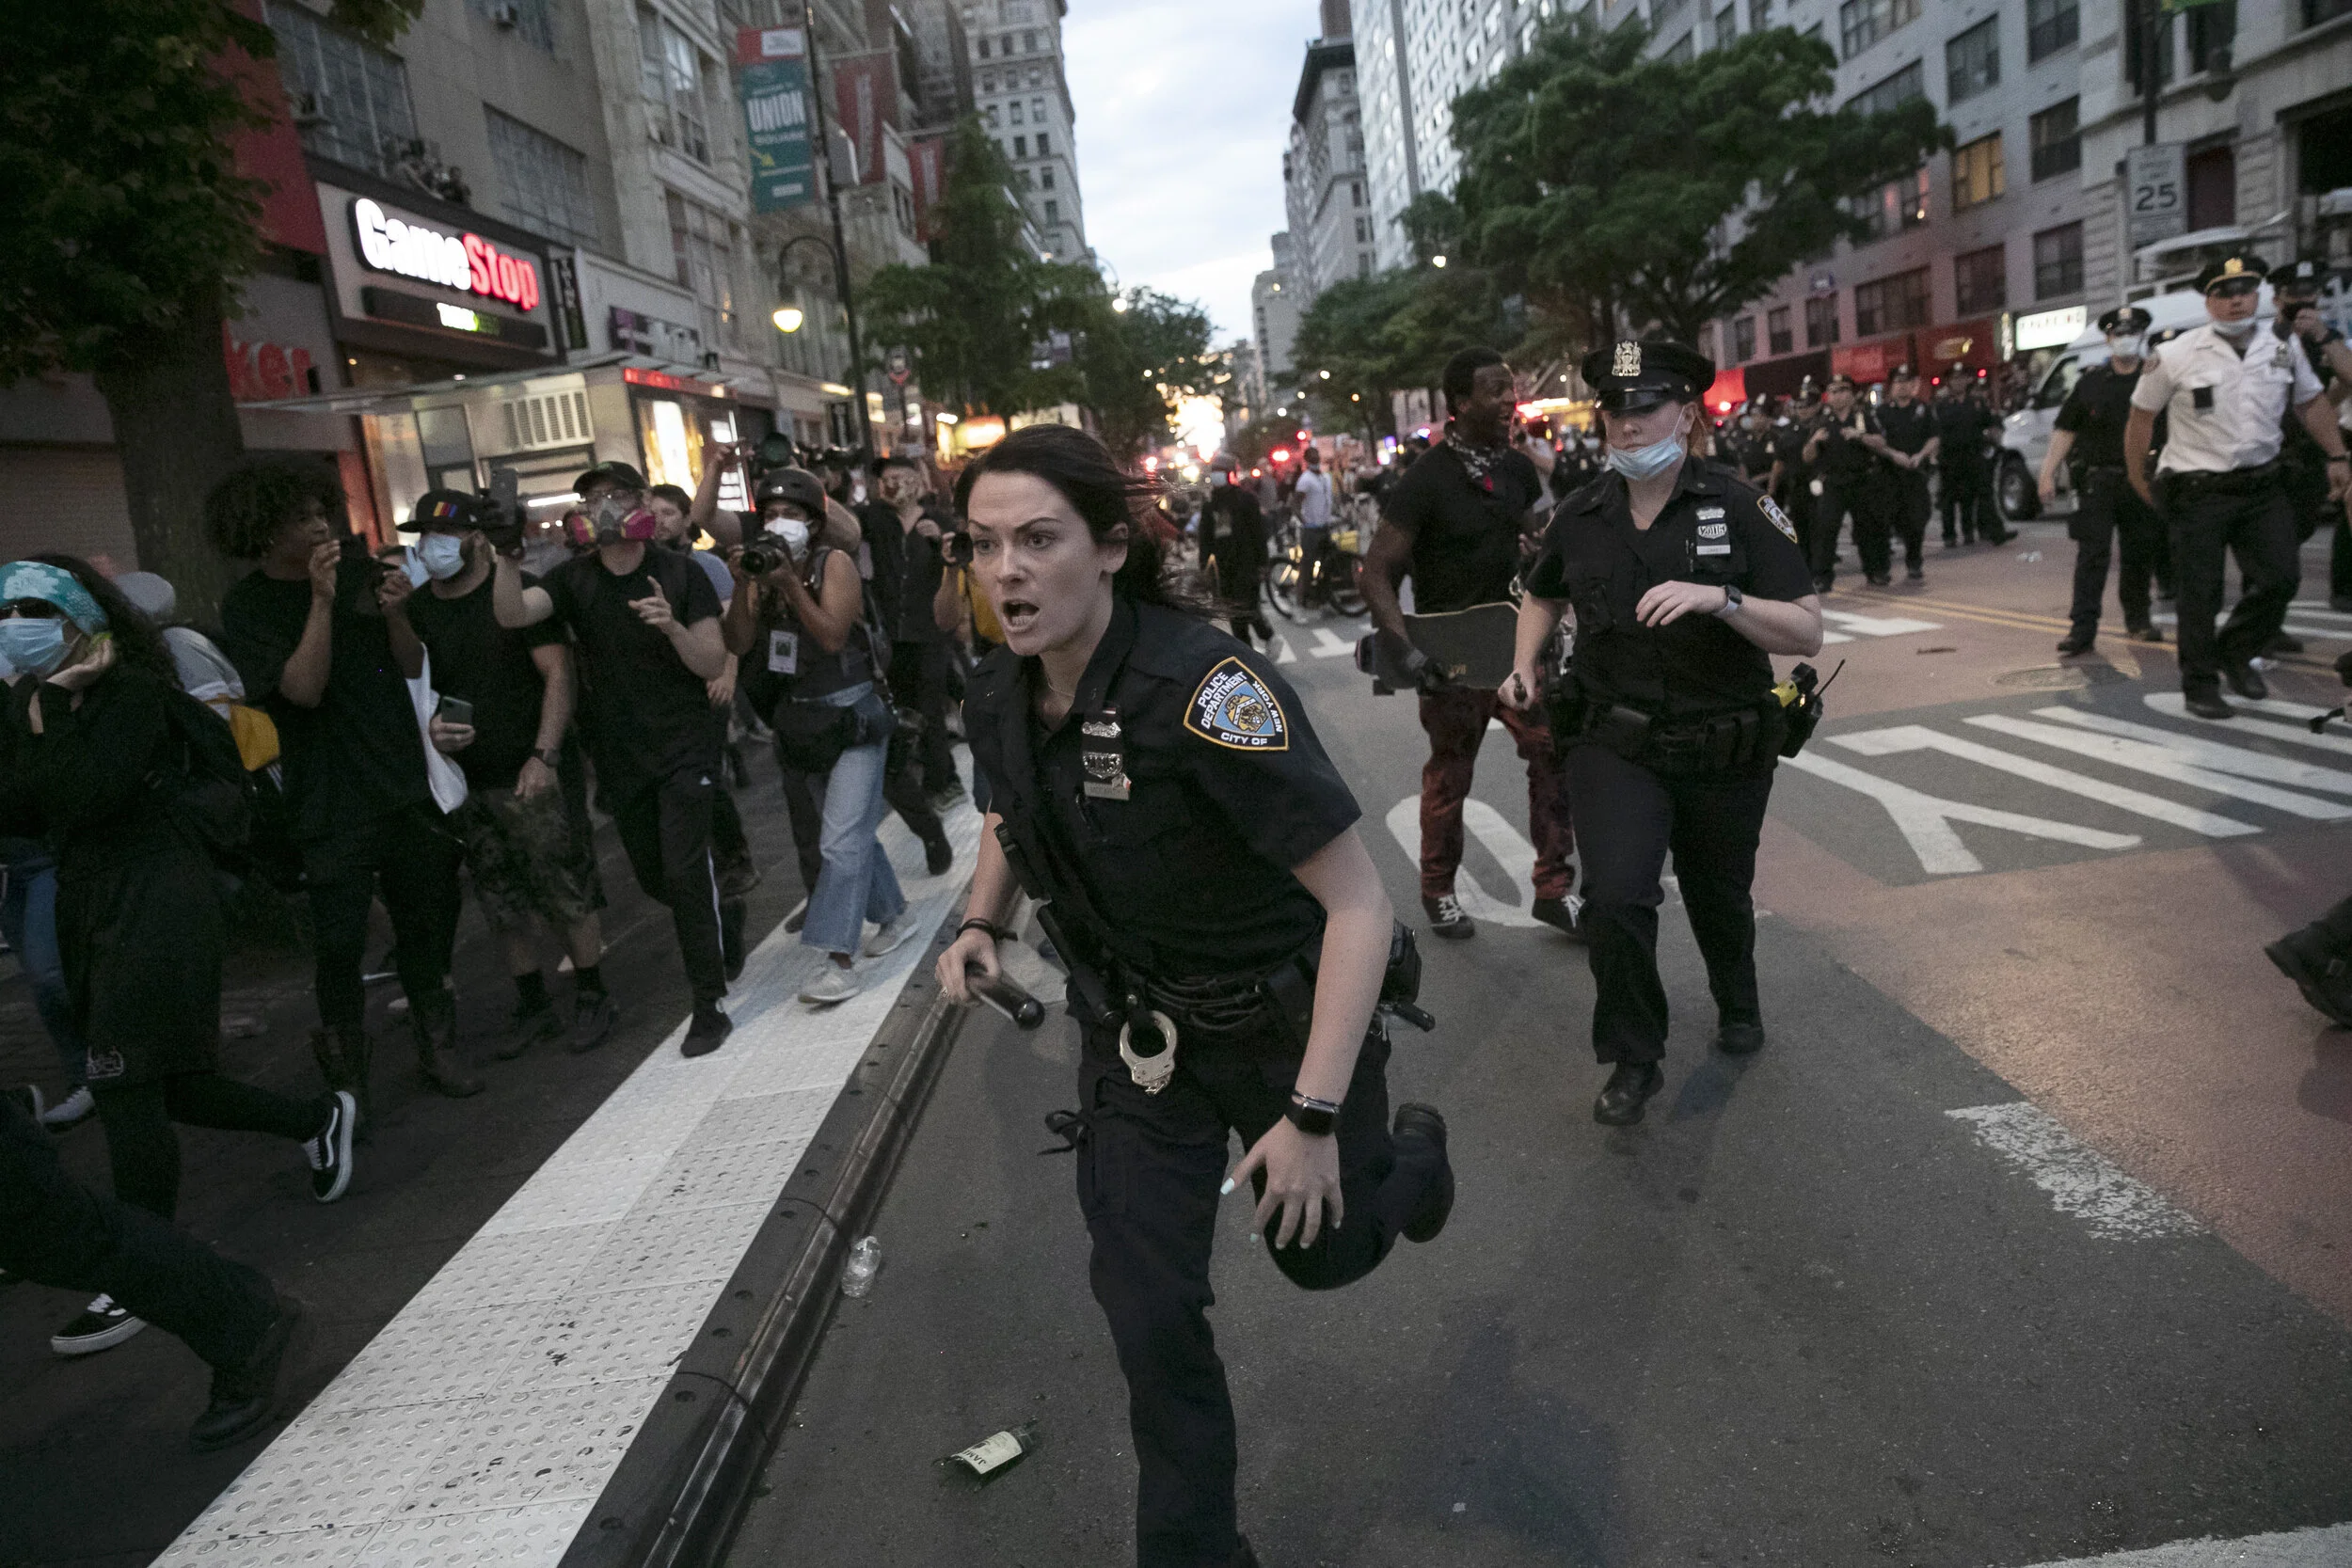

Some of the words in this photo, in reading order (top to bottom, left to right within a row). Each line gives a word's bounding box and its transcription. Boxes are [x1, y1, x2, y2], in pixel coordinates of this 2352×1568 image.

[747, 91, 805, 132] UNION
[2136, 182, 2178, 212] 25
[355, 198, 540, 311] GameStop
[1197, 671, 1229, 707] POLICE
[1200, 671, 1248, 730] DEPARTMENT
[1252, 680, 1274, 708] YORK
[1270, 709, 1283, 733] NEW
[1220, 732, 1248, 745] CITY
[1250, 736, 1268, 746] OF
